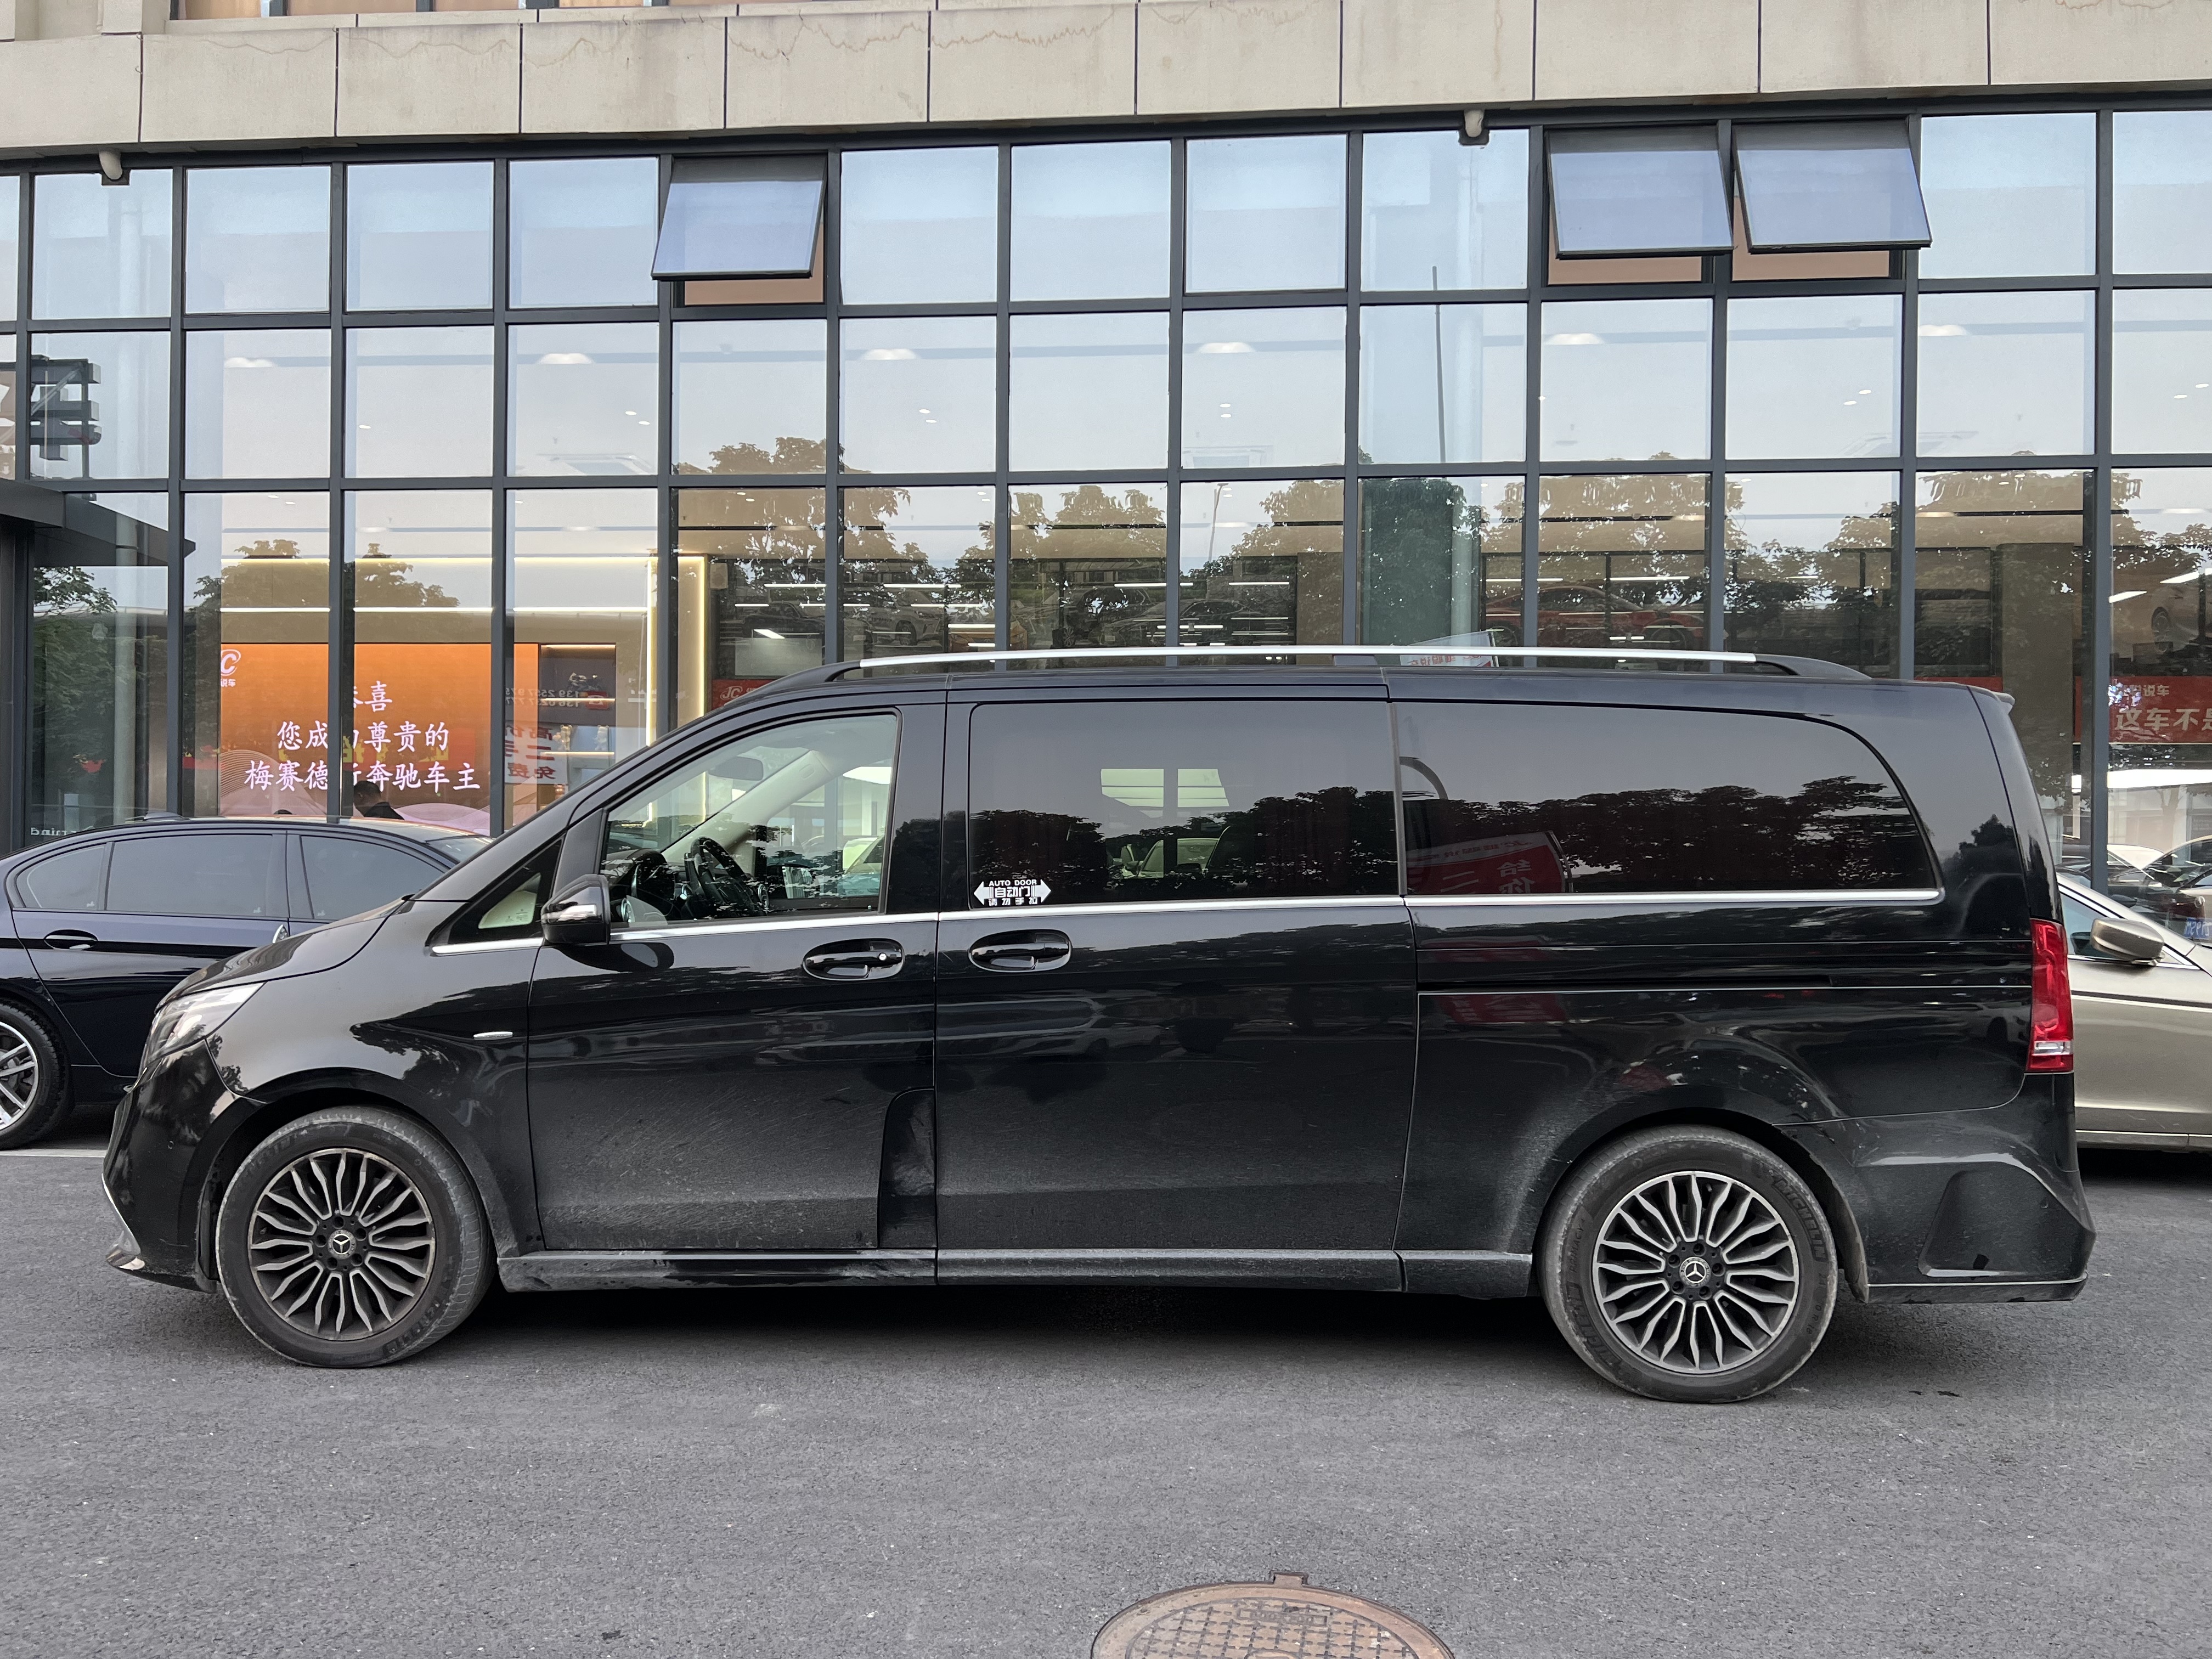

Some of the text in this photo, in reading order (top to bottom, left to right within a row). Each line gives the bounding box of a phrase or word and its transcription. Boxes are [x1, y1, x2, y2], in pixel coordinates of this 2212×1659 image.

[277, 720, 449, 753] 您成尊贵的
[244, 760, 480, 793] 梅赛德奔驰车主
[994, 885, 1031, 898] 自动门
[1774, 1179, 1827, 1259] MICHELIN
[1569, 1223, 1584, 1273] PRIMACY
